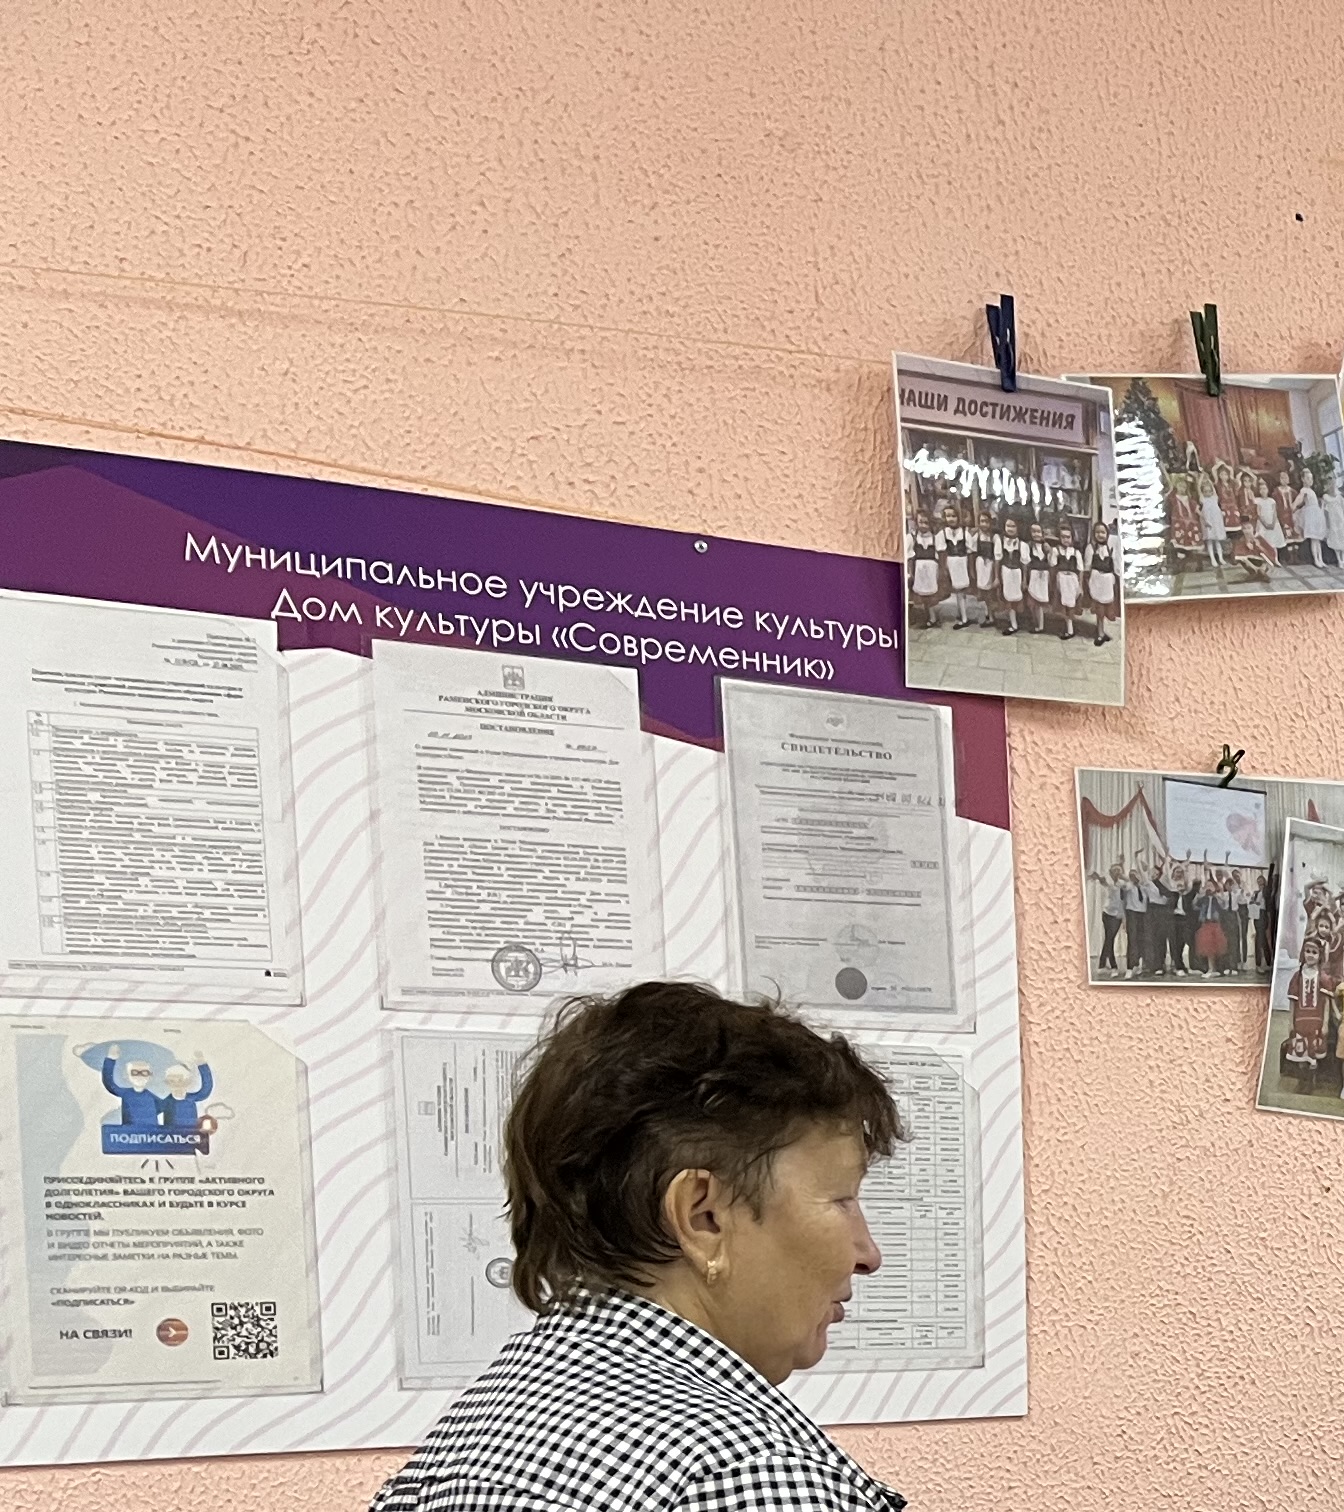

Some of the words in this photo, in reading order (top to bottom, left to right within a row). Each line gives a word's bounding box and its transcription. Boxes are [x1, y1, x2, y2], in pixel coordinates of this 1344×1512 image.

[953, 396, 1076, 431] ДОСТИЖЕНИЯ
[184, 532, 508, 598] Муниципальное
[518, 578, 744, 629] учреждение
[755, 610, 899, 652] культуры
[271, 588, 363, 625] Дом
[376, 604, 541, 648] культуры
[551, 622, 835, 681] «Современник»
[110, 1133, 201, 1145] ПОДПИСАТЬСЯ
[59, 1329, 80, 1340] НА
[83, 1328, 133, 1340] СВЯЗИ!
